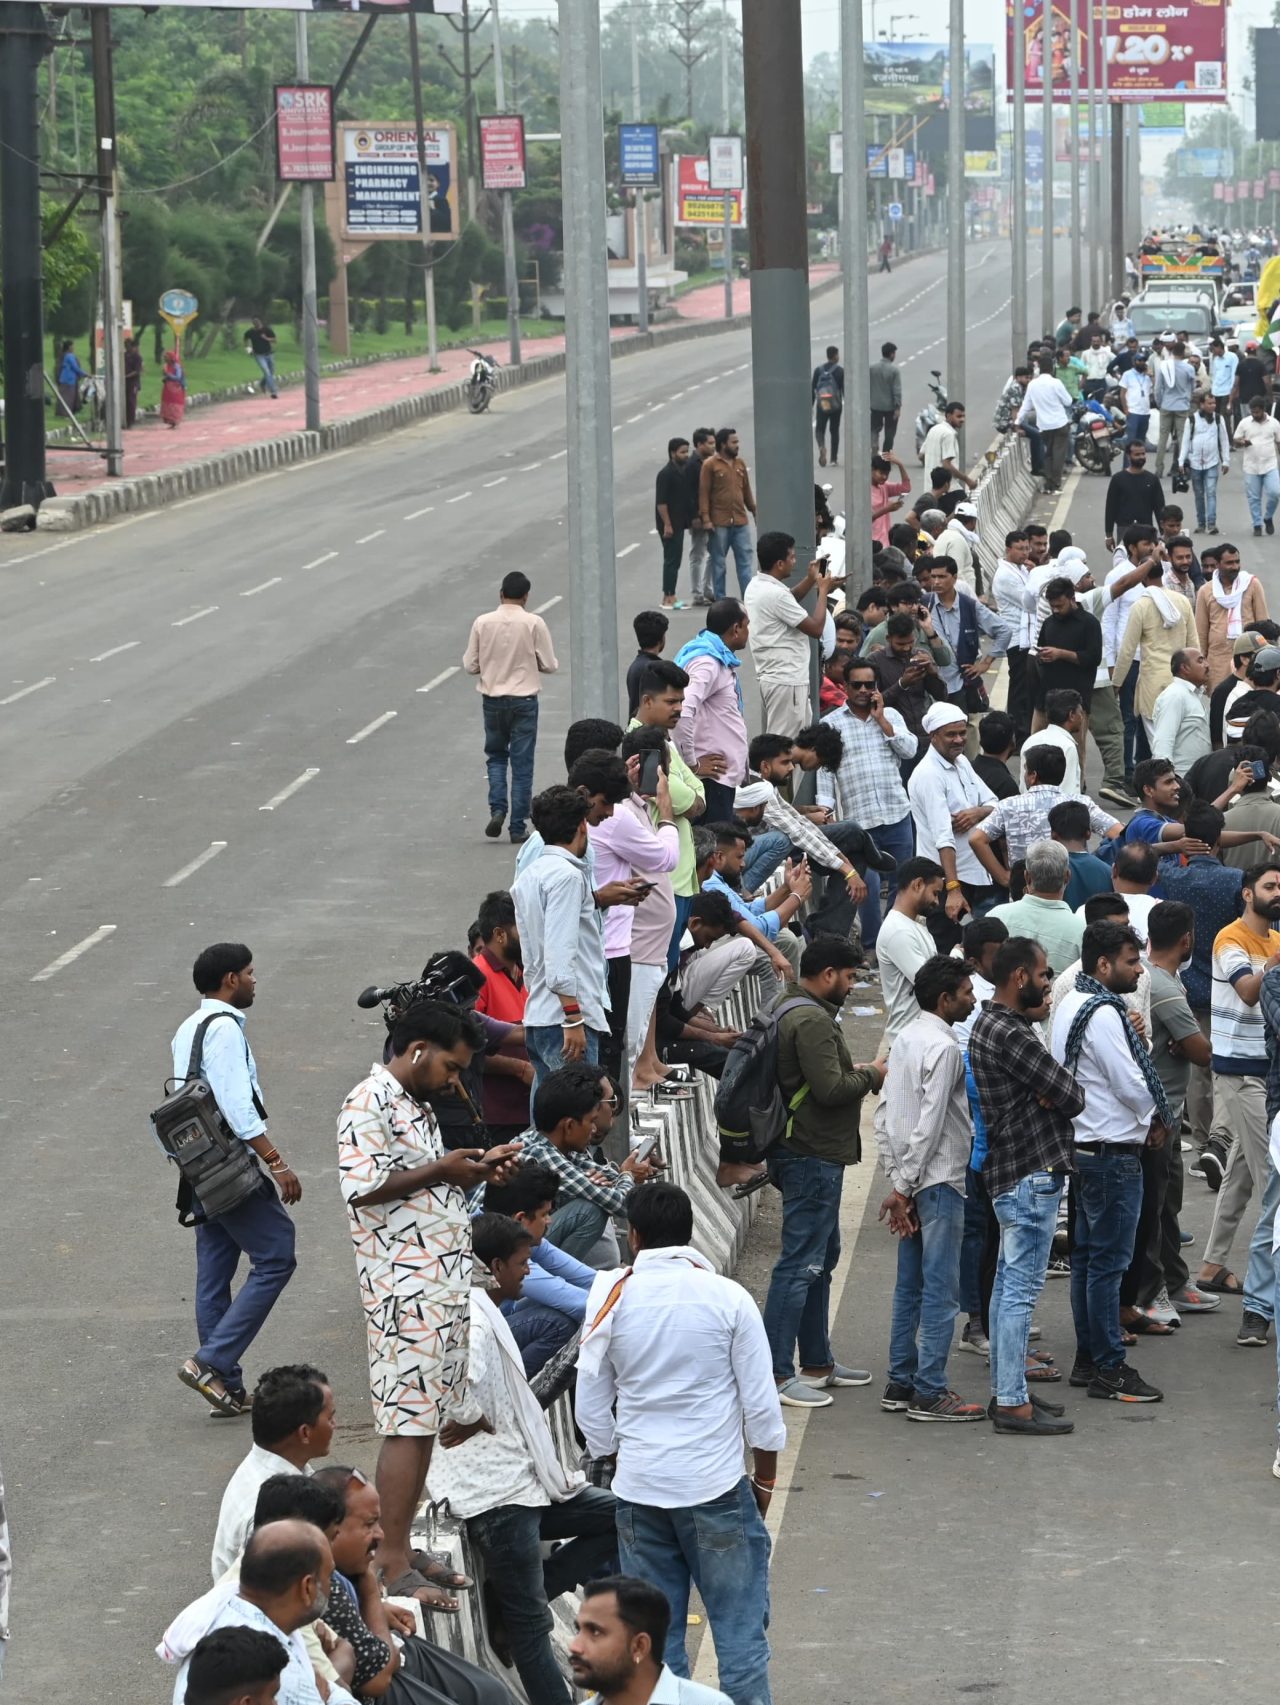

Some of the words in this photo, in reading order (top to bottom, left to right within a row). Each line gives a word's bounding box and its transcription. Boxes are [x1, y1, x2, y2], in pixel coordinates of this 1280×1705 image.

[294, 92, 328, 107] SRK
[374, 132, 441, 142] ORIENAL
[354, 165, 417, 175] ENGINEERING
[355, 178, 408, 188] PHARMACY
[355, 191, 420, 201] MANAGEMENT
